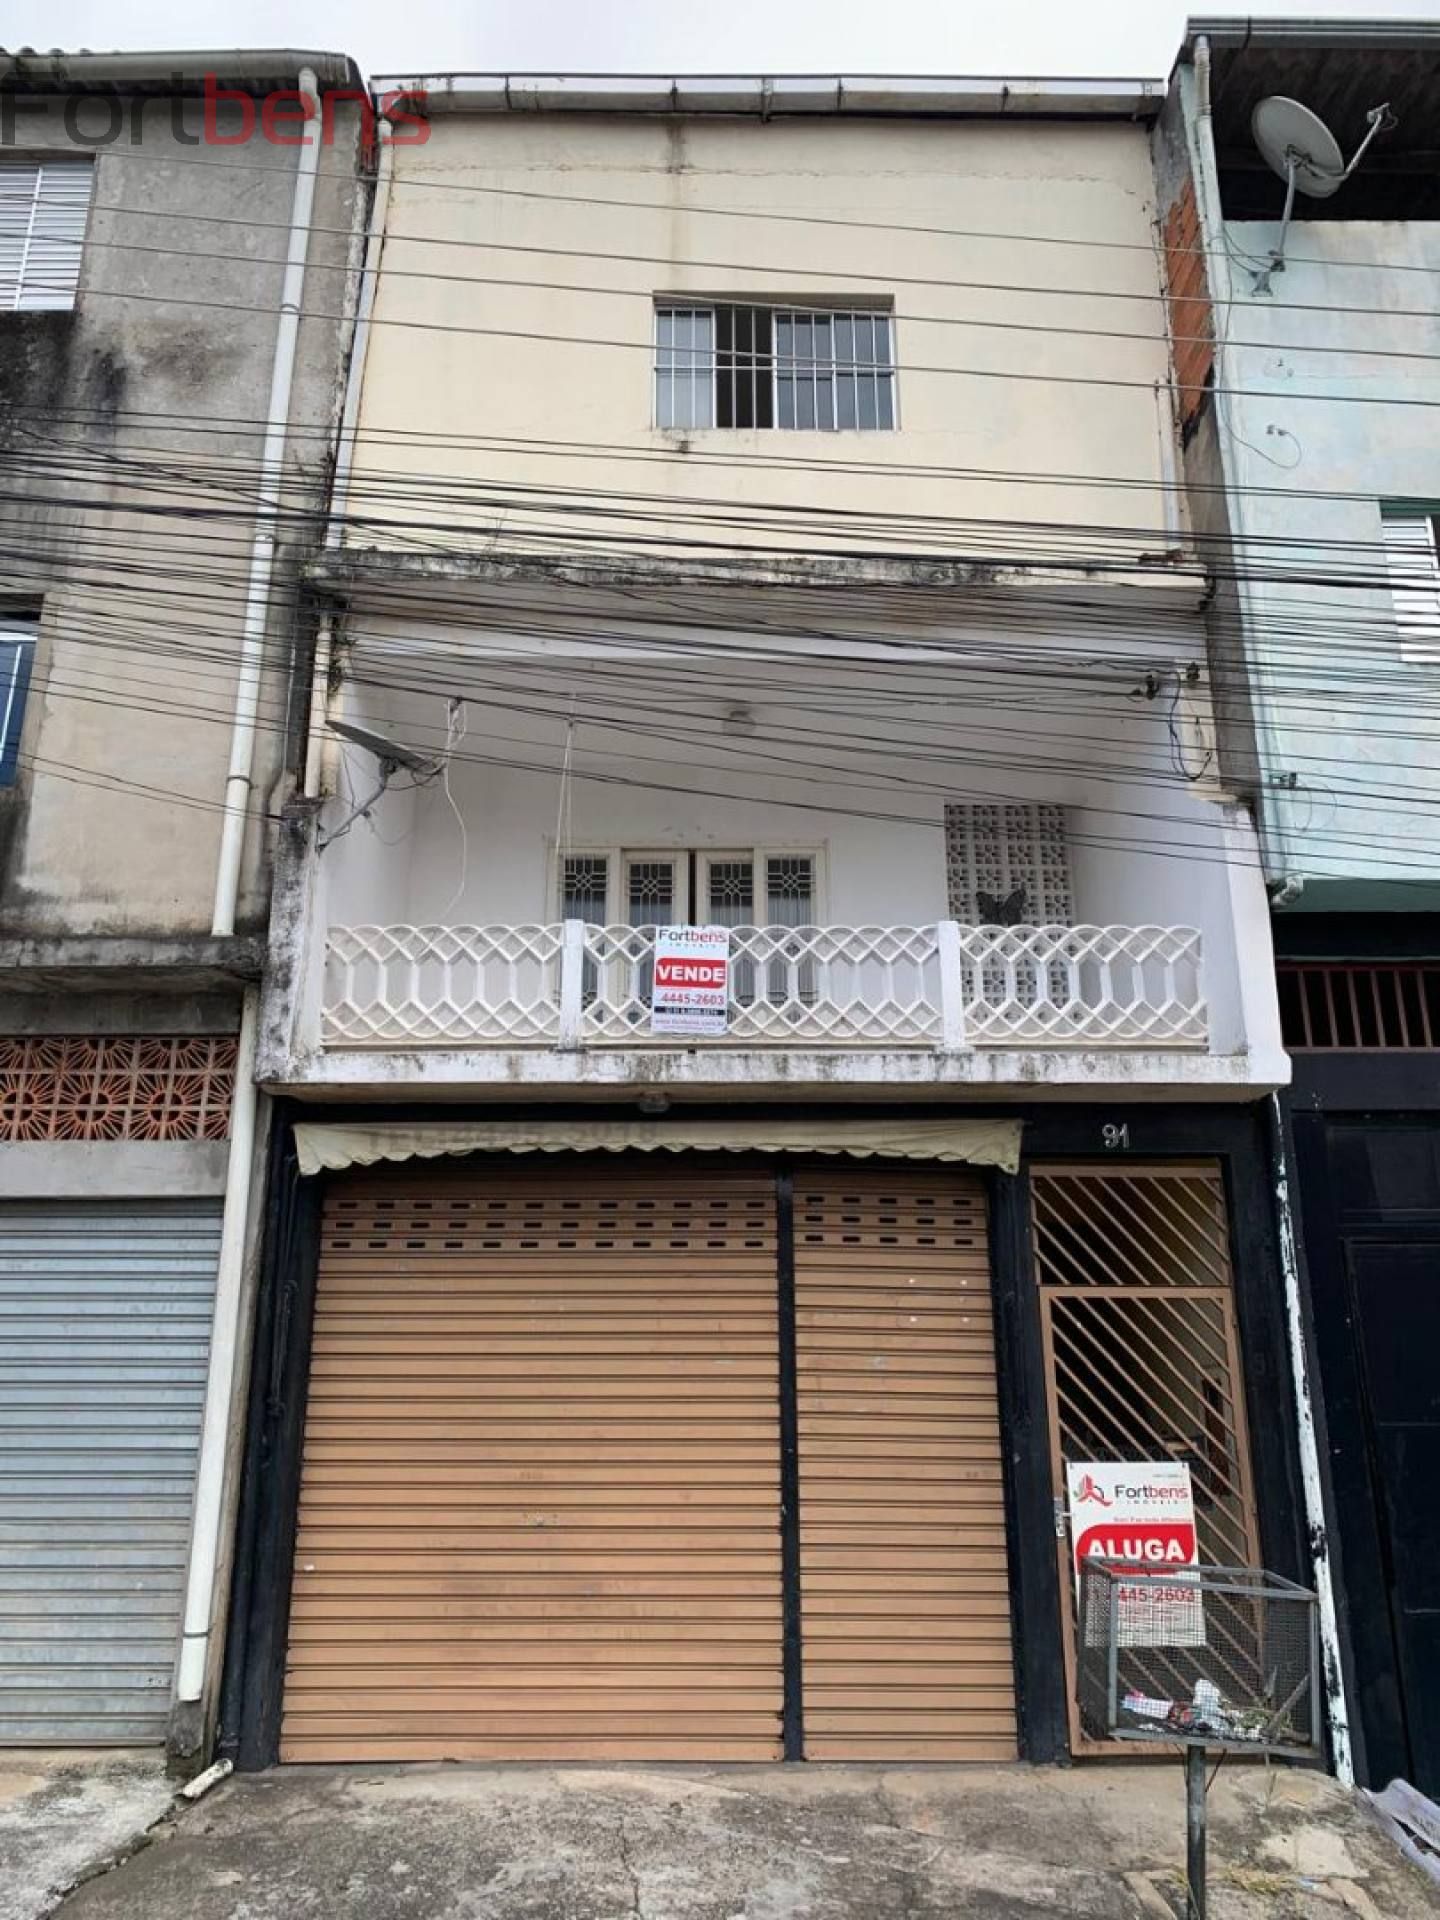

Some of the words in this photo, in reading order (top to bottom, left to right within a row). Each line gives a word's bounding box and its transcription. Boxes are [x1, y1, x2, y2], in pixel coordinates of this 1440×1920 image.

[659, 929, 727, 943] Fortbens
[656, 964, 725, 983] VENDE
[662, 992, 724, 1006] 4445-2603
[1101, 1123, 1130, 1149] 91
[1114, 1484, 1188, 1499] Fortbens
[1087, 1538, 1186, 1561] ALUGA
